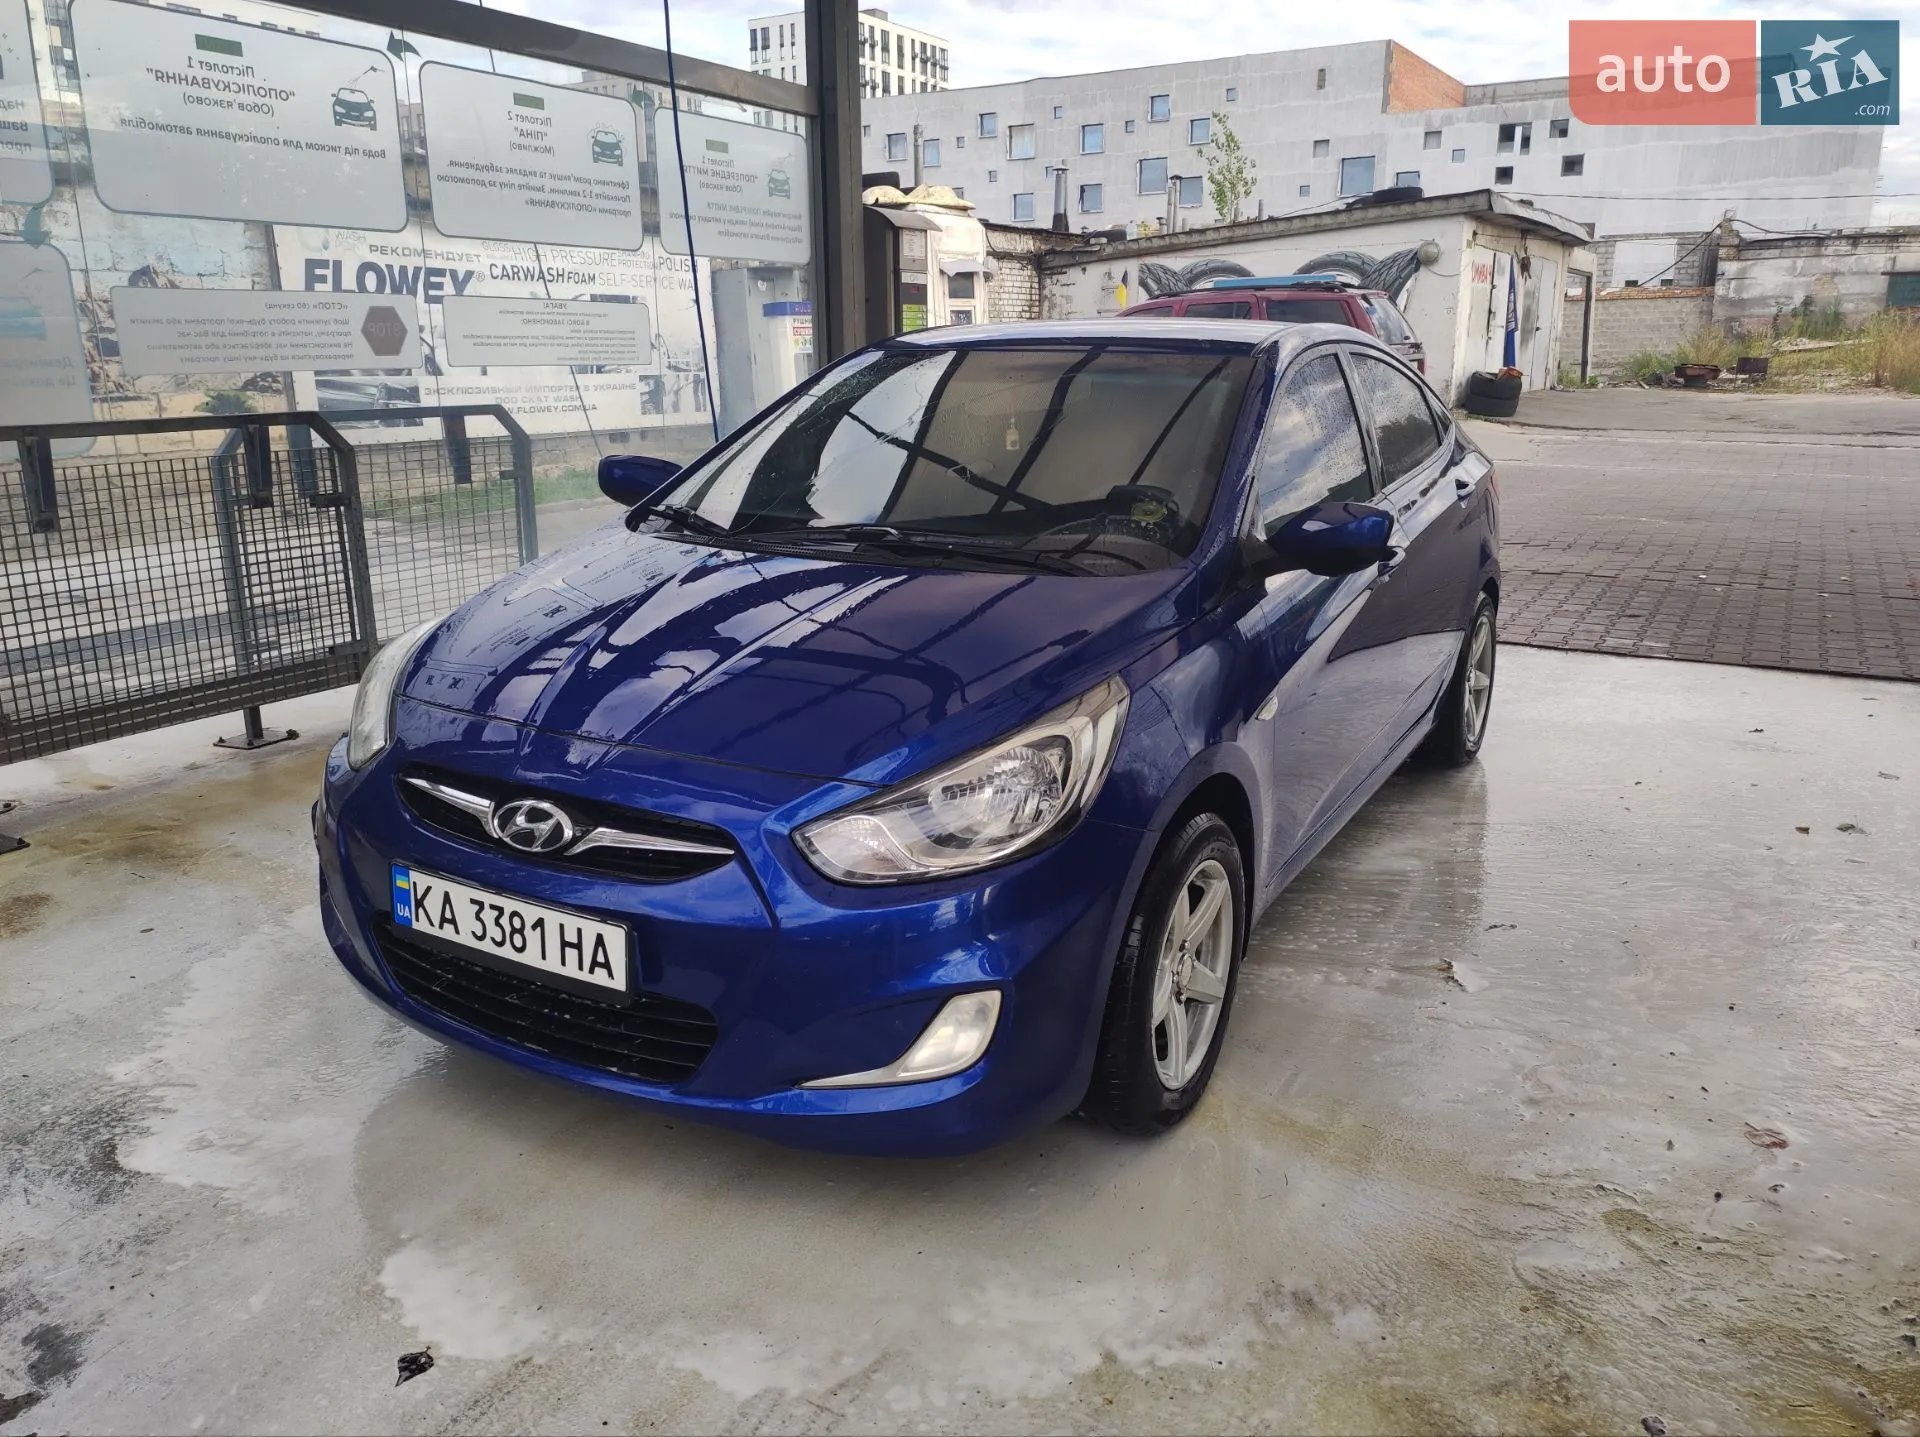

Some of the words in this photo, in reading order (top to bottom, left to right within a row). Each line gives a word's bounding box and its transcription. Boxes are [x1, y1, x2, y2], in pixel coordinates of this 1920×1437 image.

[369, 244, 481, 263] РЕКОМЕНДУЕТ
[512, 246, 548, 264] HIGH
[551, 248, 618, 268] PRESSURE
[489, 262, 566, 284] CARWASH
[567, 271, 597, 286] FOAM
[598, 272, 675, 291] SELF-SERVICE
[592, 382, 638, 392] УКРАИНЕ
[397, 902, 411, 919] UA
[412, 880, 460, 935] KA
[469, 897, 547, 961] 3381
[559, 922, 615, 980] HA
